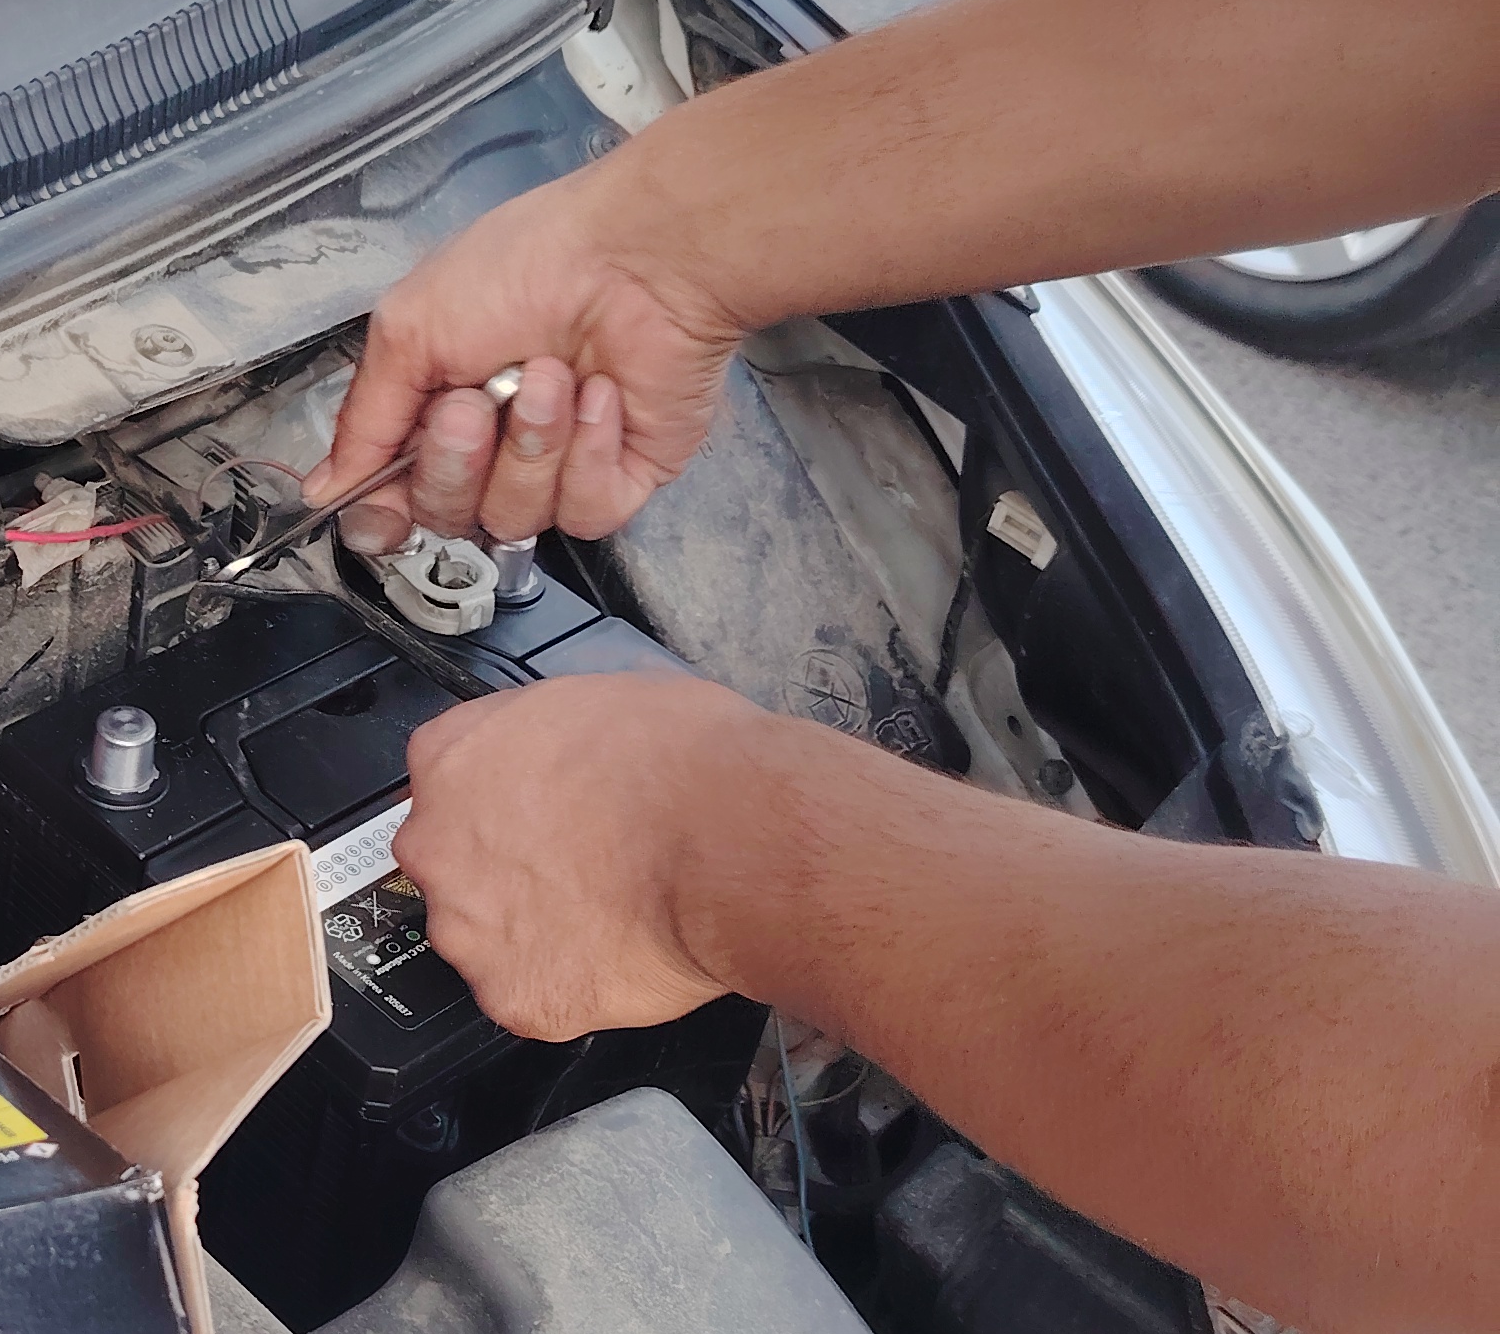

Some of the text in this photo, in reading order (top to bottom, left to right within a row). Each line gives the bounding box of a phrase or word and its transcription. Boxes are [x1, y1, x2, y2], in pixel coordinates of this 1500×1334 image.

[333, 951, 353, 971] Made
[353, 970, 362, 980] in
[359, 974, 384, 995] Korea
